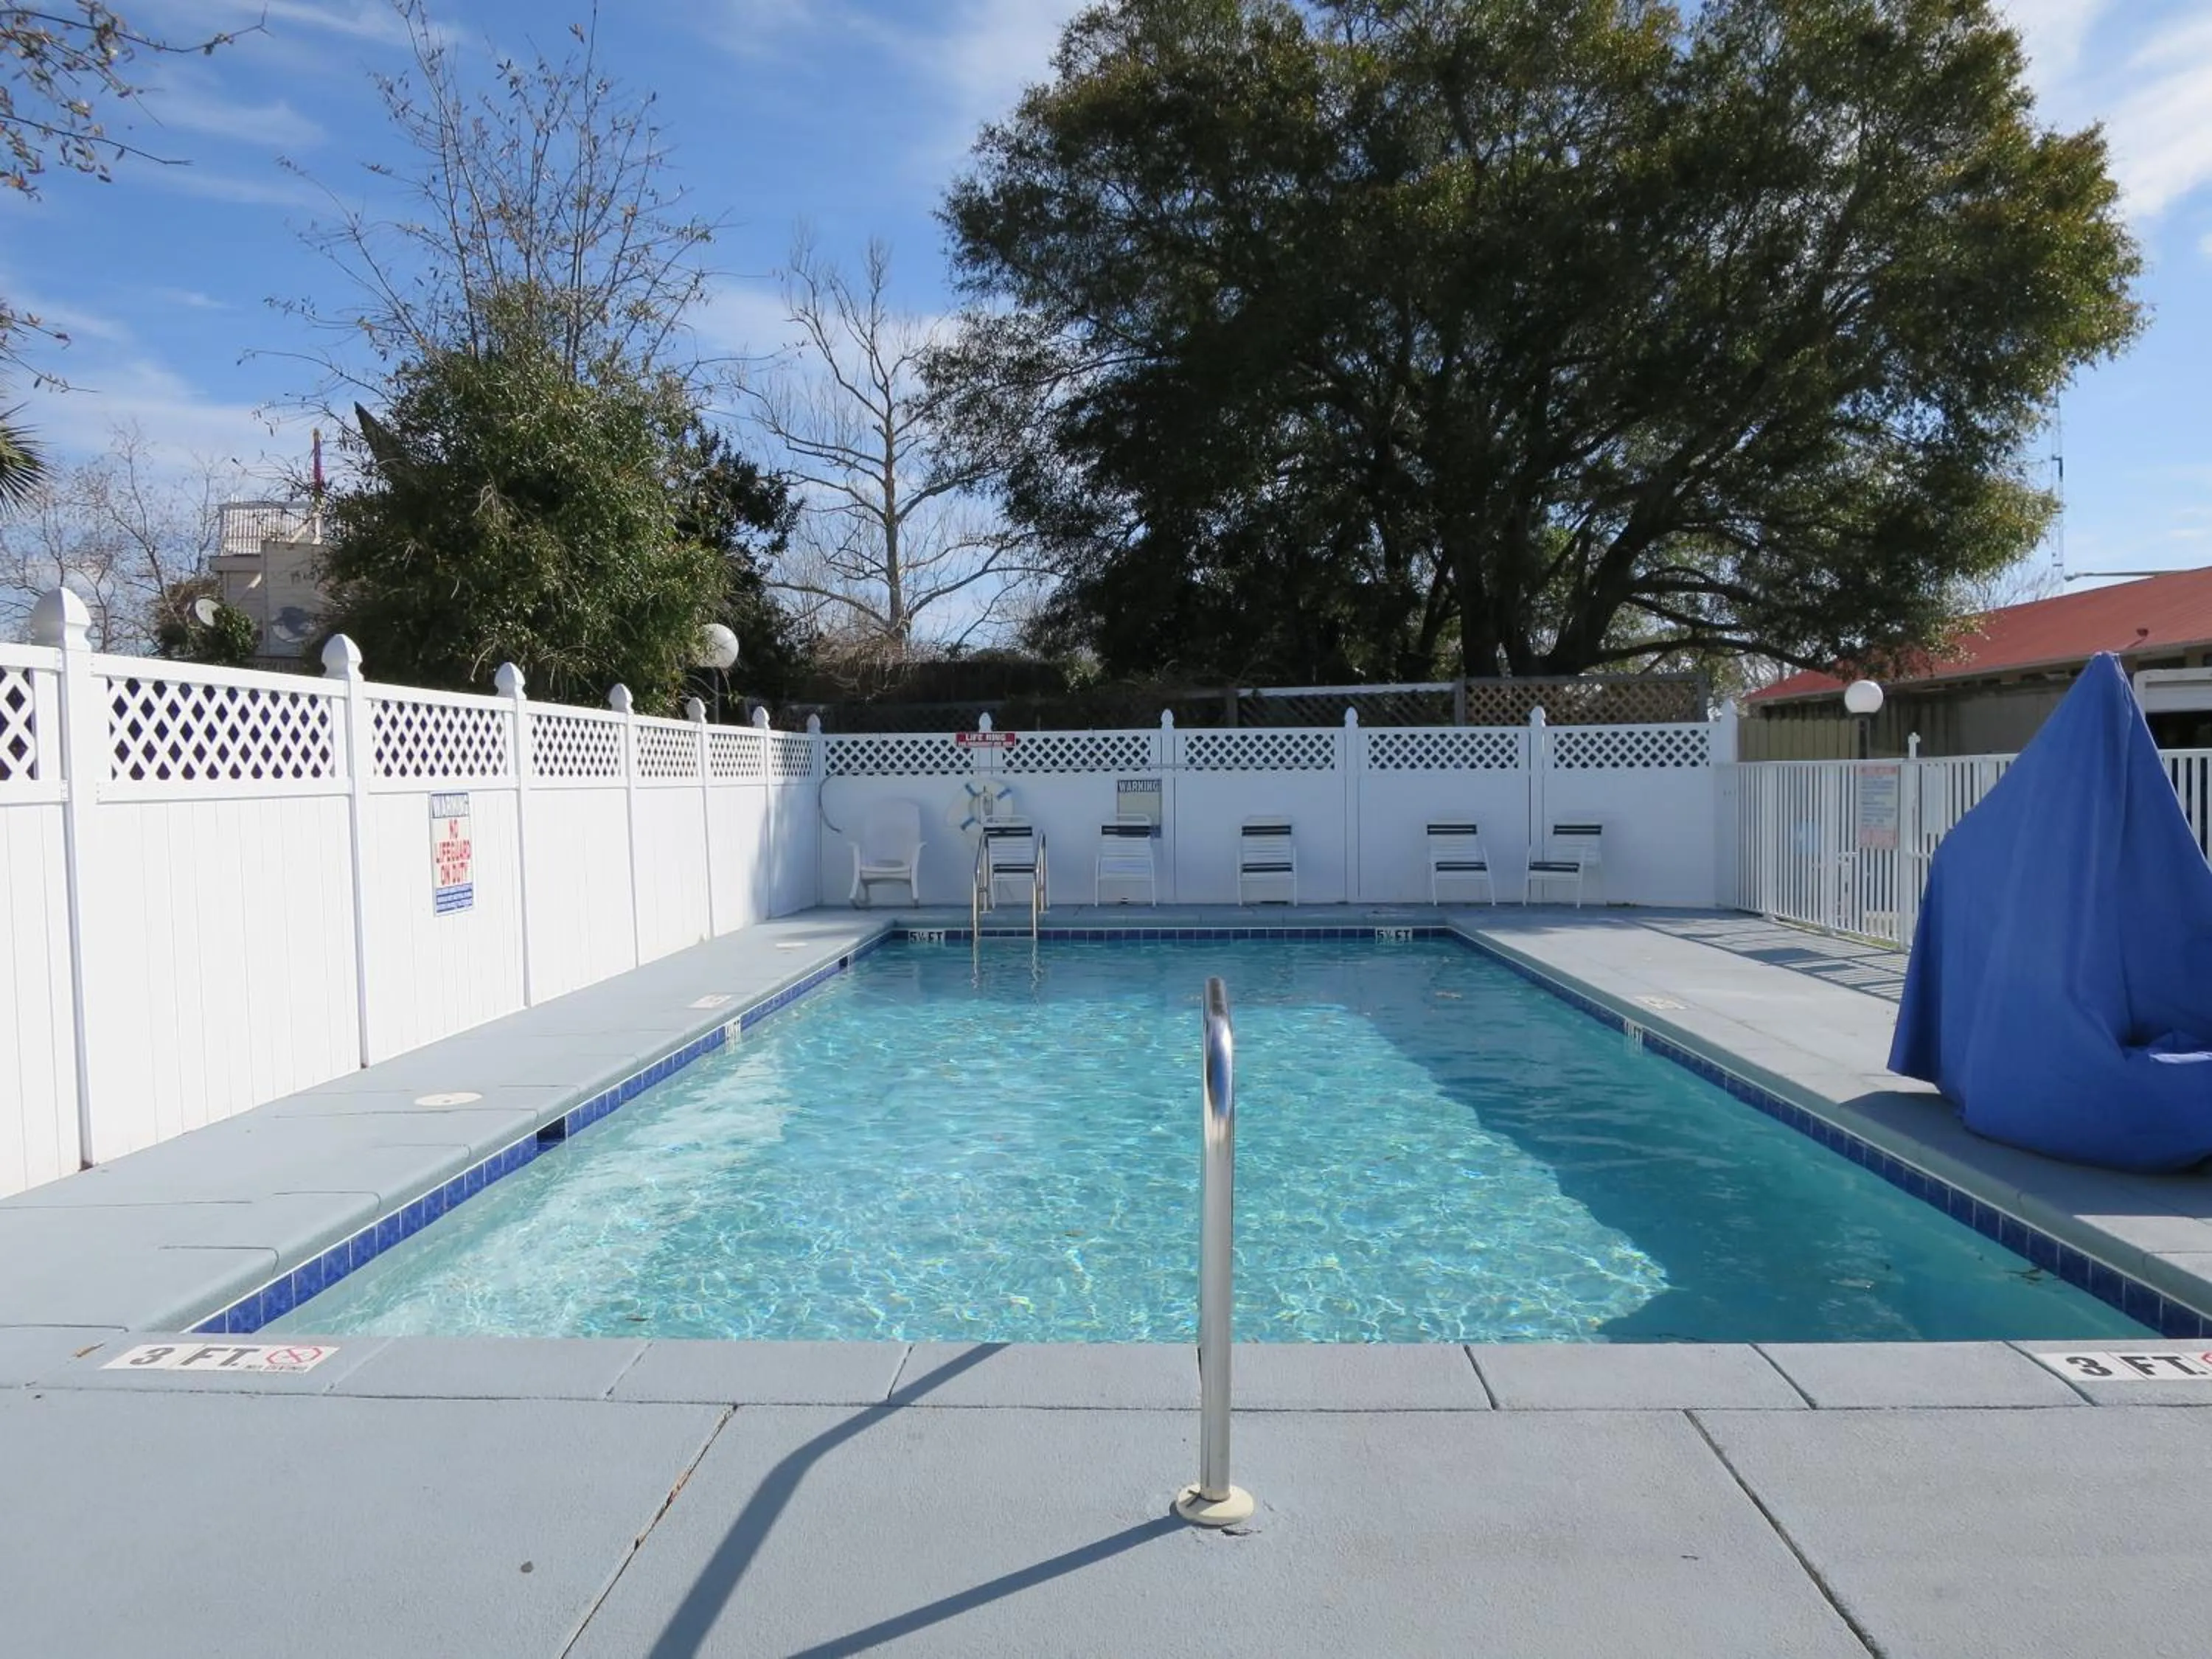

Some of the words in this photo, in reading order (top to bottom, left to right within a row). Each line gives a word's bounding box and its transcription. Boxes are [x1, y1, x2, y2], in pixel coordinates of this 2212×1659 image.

[965, 733, 983, 741] LIFE
[987, 733, 1006, 741] RING
[1119, 780, 1160, 792] WARNING
[448, 818, 459, 840] NO
[435, 840, 472, 864] LIFEGUARD
[441, 864, 451, 886] ON
[451, 862, 468, 884] DUTY
[129, 1347, 175, 1366] 3
[2065, 1356, 2112, 1377] 3
[2119, 1356, 2208, 1376] FT.
